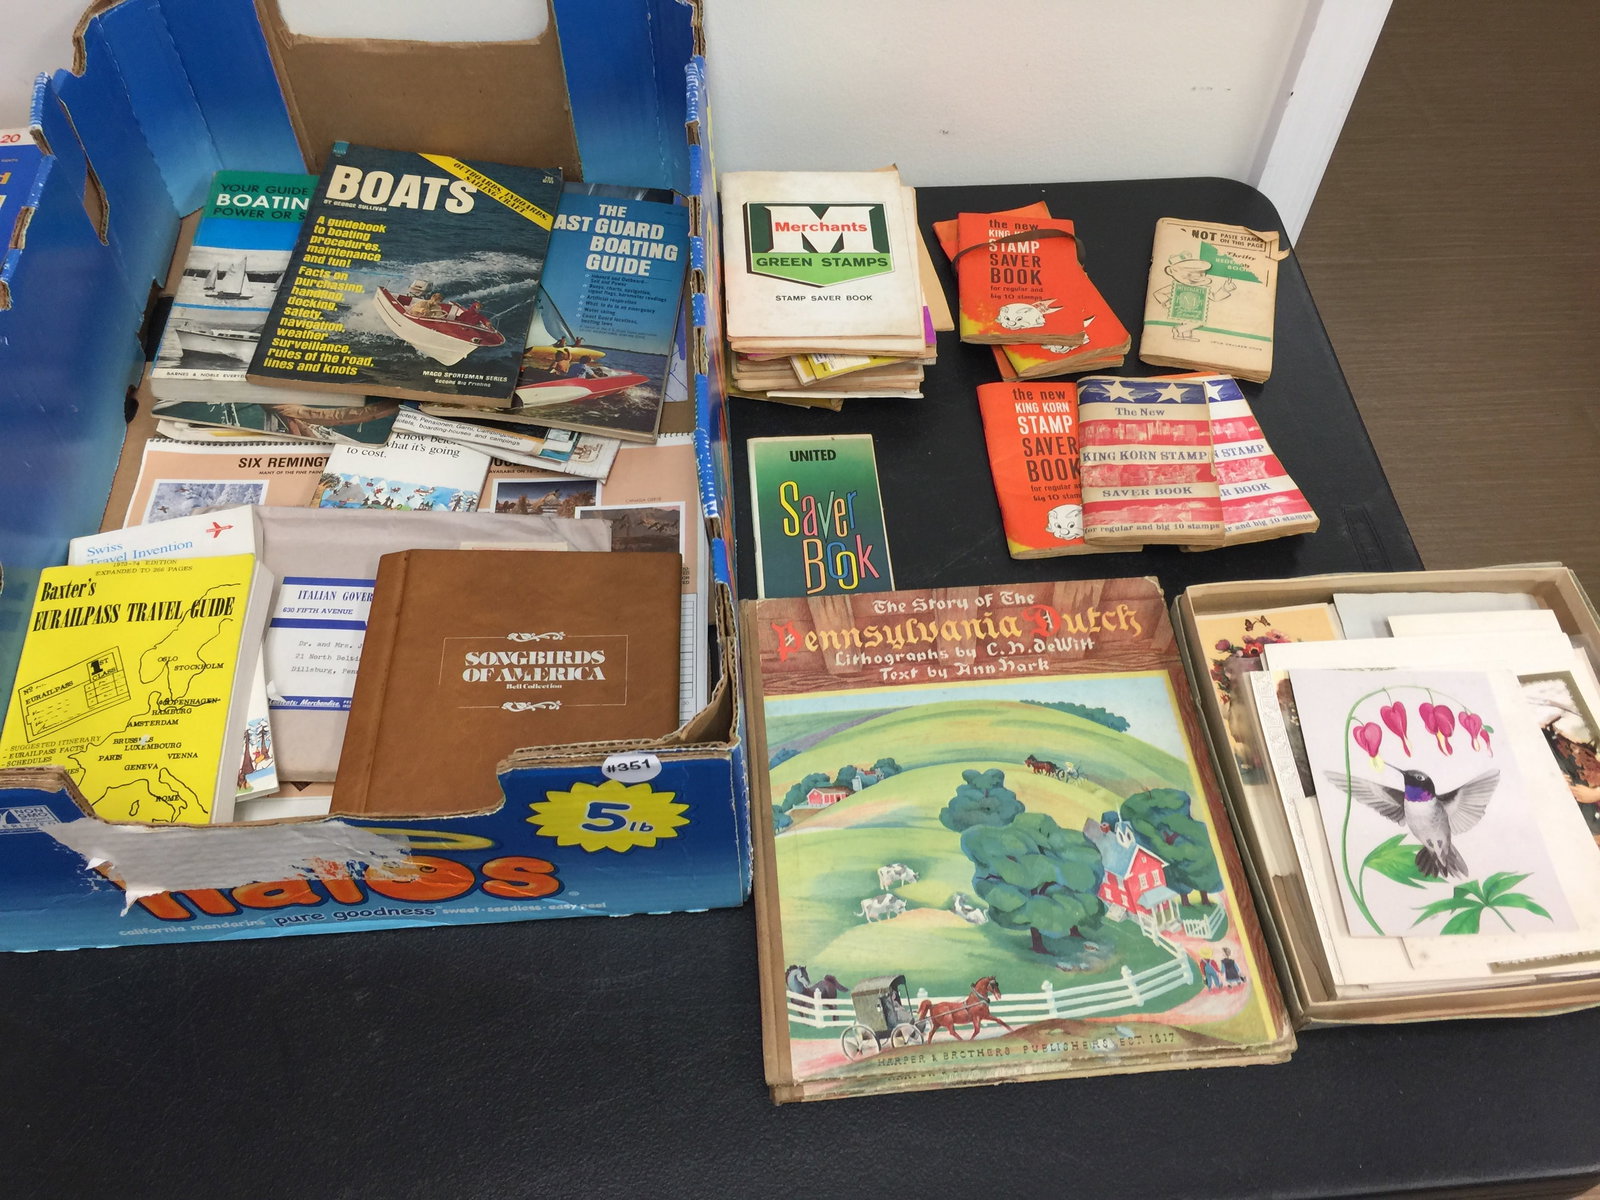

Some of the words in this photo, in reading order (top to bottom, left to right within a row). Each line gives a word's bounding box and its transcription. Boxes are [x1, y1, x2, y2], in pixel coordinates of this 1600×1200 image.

[221, 184, 260, 193] YOUR
[265, 186, 309, 196] GUIDE
[325, 164, 478, 214] BOATS
[464, 176, 498, 197] SAILING
[499, 196, 528, 214] CRAFT
[216, 194, 310, 210] BOATIN
[358, 204, 388, 212] SULLIVAN
[213, 207, 264, 218] POWER
[272, 210, 292, 220] OR
[599, 204, 628, 218] THE
[316, 216, 325, 224] A
[328, 218, 386, 233] guidebook
[594, 218, 664, 240] GUARD
[774, 222, 868, 232] Merchants
[989, 219, 1008, 229] the
[1014, 222, 1039, 230] new
[314, 224, 325, 234] to
[328, 227, 371, 241] boating
[1192, 230, 1217, 241] NOT
[306, 244, 382, 262] maintenance
[590, 236, 678, 261] BOATING
[988, 238, 1040, 254] STAMP
[303, 254, 325, 264] and
[586, 254, 652, 276] GUIDE
[756, 257, 812, 267] GREEN
[822, 257, 888, 267] STAMPS
[990, 254, 1041, 268] SAVER
[298, 266, 331, 279] Facts
[334, 272, 348, 280] on
[991, 267, 1042, 285] BOOK
[276, 327, 328, 340] weather
[267, 347, 302, 360] rules
[304, 352, 318, 361] of
[320, 352, 339, 363] the
[263, 358, 294, 370] lines
[297, 362, 321, 372] and
[323, 364, 358, 376] knots
[444, 372, 484, 380] SPORTSMAN
[1012, 388, 1034, 400] the
[1040, 390, 1065, 400] new
[1015, 402, 1039, 413] KING
[1042, 402, 1070, 413] KORN
[1114, 407, 1137, 416] The
[1140, 408, 1165, 416] New
[1018, 415, 1073, 434] STAMP
[362, 449, 387, 458] cost.
[412, 442, 426, 452] it's
[429, 446, 460, 458] going
[1022, 436, 1078, 457] SAVER
[1221, 444, 1264, 458] STAMP
[238, 458, 262, 468] SIX
[790, 450, 836, 462] UNITED
[1082, 451, 1116, 462] KING
[1120, 450, 1156, 460] KORN
[1160, 451, 1208, 460] STAMP
[1026, 458, 1080, 482] BOOK
[1044, 484, 1071, 492] regular
[1102, 488, 1150, 498] SAVER
[1154, 487, 1192, 495] BOOK
[1234, 483, 1270, 494] BOOK
[778, 480, 858, 542] Saver
[1283, 513, 1312, 521] stamps
[1100, 525, 1133, 533] regular
[1156, 523, 1170, 531] big
[87, 543, 123, 557] Swiss
[133, 541, 193, 559] Invention
[96, 567, 137, 576] EXPANDED
[802, 534, 880, 595] Book
[40, 578, 97, 602] Baxter's
[298, 590, 336, 600] ITALIAN
[872, 600, 905, 614] The
[912, 598, 968, 612] Story
[974, 593, 993, 607] of
[1000, 591, 1035, 605] The
[32, 604, 121, 632] EURAILPASS
[126, 600, 183, 622] TRAVEL
[190, 596, 235, 619] GUIDE
[770, 612, 1023, 662] Pennsylvania
[1022, 603, 1142, 637] Dutch
[465, 649, 606, 666] SONGBIRDS
[835, 648, 949, 666] Lithographs
[955, 647, 976, 658] by
[92, 667, 117, 681] CLASS
[174, 663, 224, 671] STOCKHOLM
[291, 666, 336, 674] Dillsburg,
[879, 667, 918, 681] Text
[927, 666, 948, 679] by
[954, 662, 996, 676] Ann
[462, 668, 495, 682] OF
[495, 667, 606, 682] AMERICA
[25, 680, 74, 705] EURAILPASS
[166, 698, 218, 706] COPENHAGEN
[152, 708, 192, 716] HAMBURG
[127, 719, 179, 728] AMSTERDAM
[10, 741, 56, 752] SUGGESTED
[58, 736, 101, 749] ITINERARY
[124, 742, 182, 751] LUXEMBOURG
[9, 749, 56, 759] EURAILPASS
[59, 745, 85, 753] FACTS
[6, 756, 52, 767] SCHEDULES
[124, 763, 159, 771] GENEVA
[606, 759, 651, 773] #351
[582, 802, 630, 832] 5
[629, 821, 654, 832] lb
[442, 906, 480, 914] sweet
[487, 905, 542, 913] seedless
[119, 926, 186, 936] california
[191, 918, 266, 931] mandarins
[273, 912, 325, 927] pure
[332, 906, 436, 921] goodness
[878, 1054, 926, 1066] HARPER
[943, 1047, 1010, 1060] BROTHERS
[1023, 1039, 1108, 1054] PUBLISHERS
[1150, 1033, 1174, 1044] 1817
